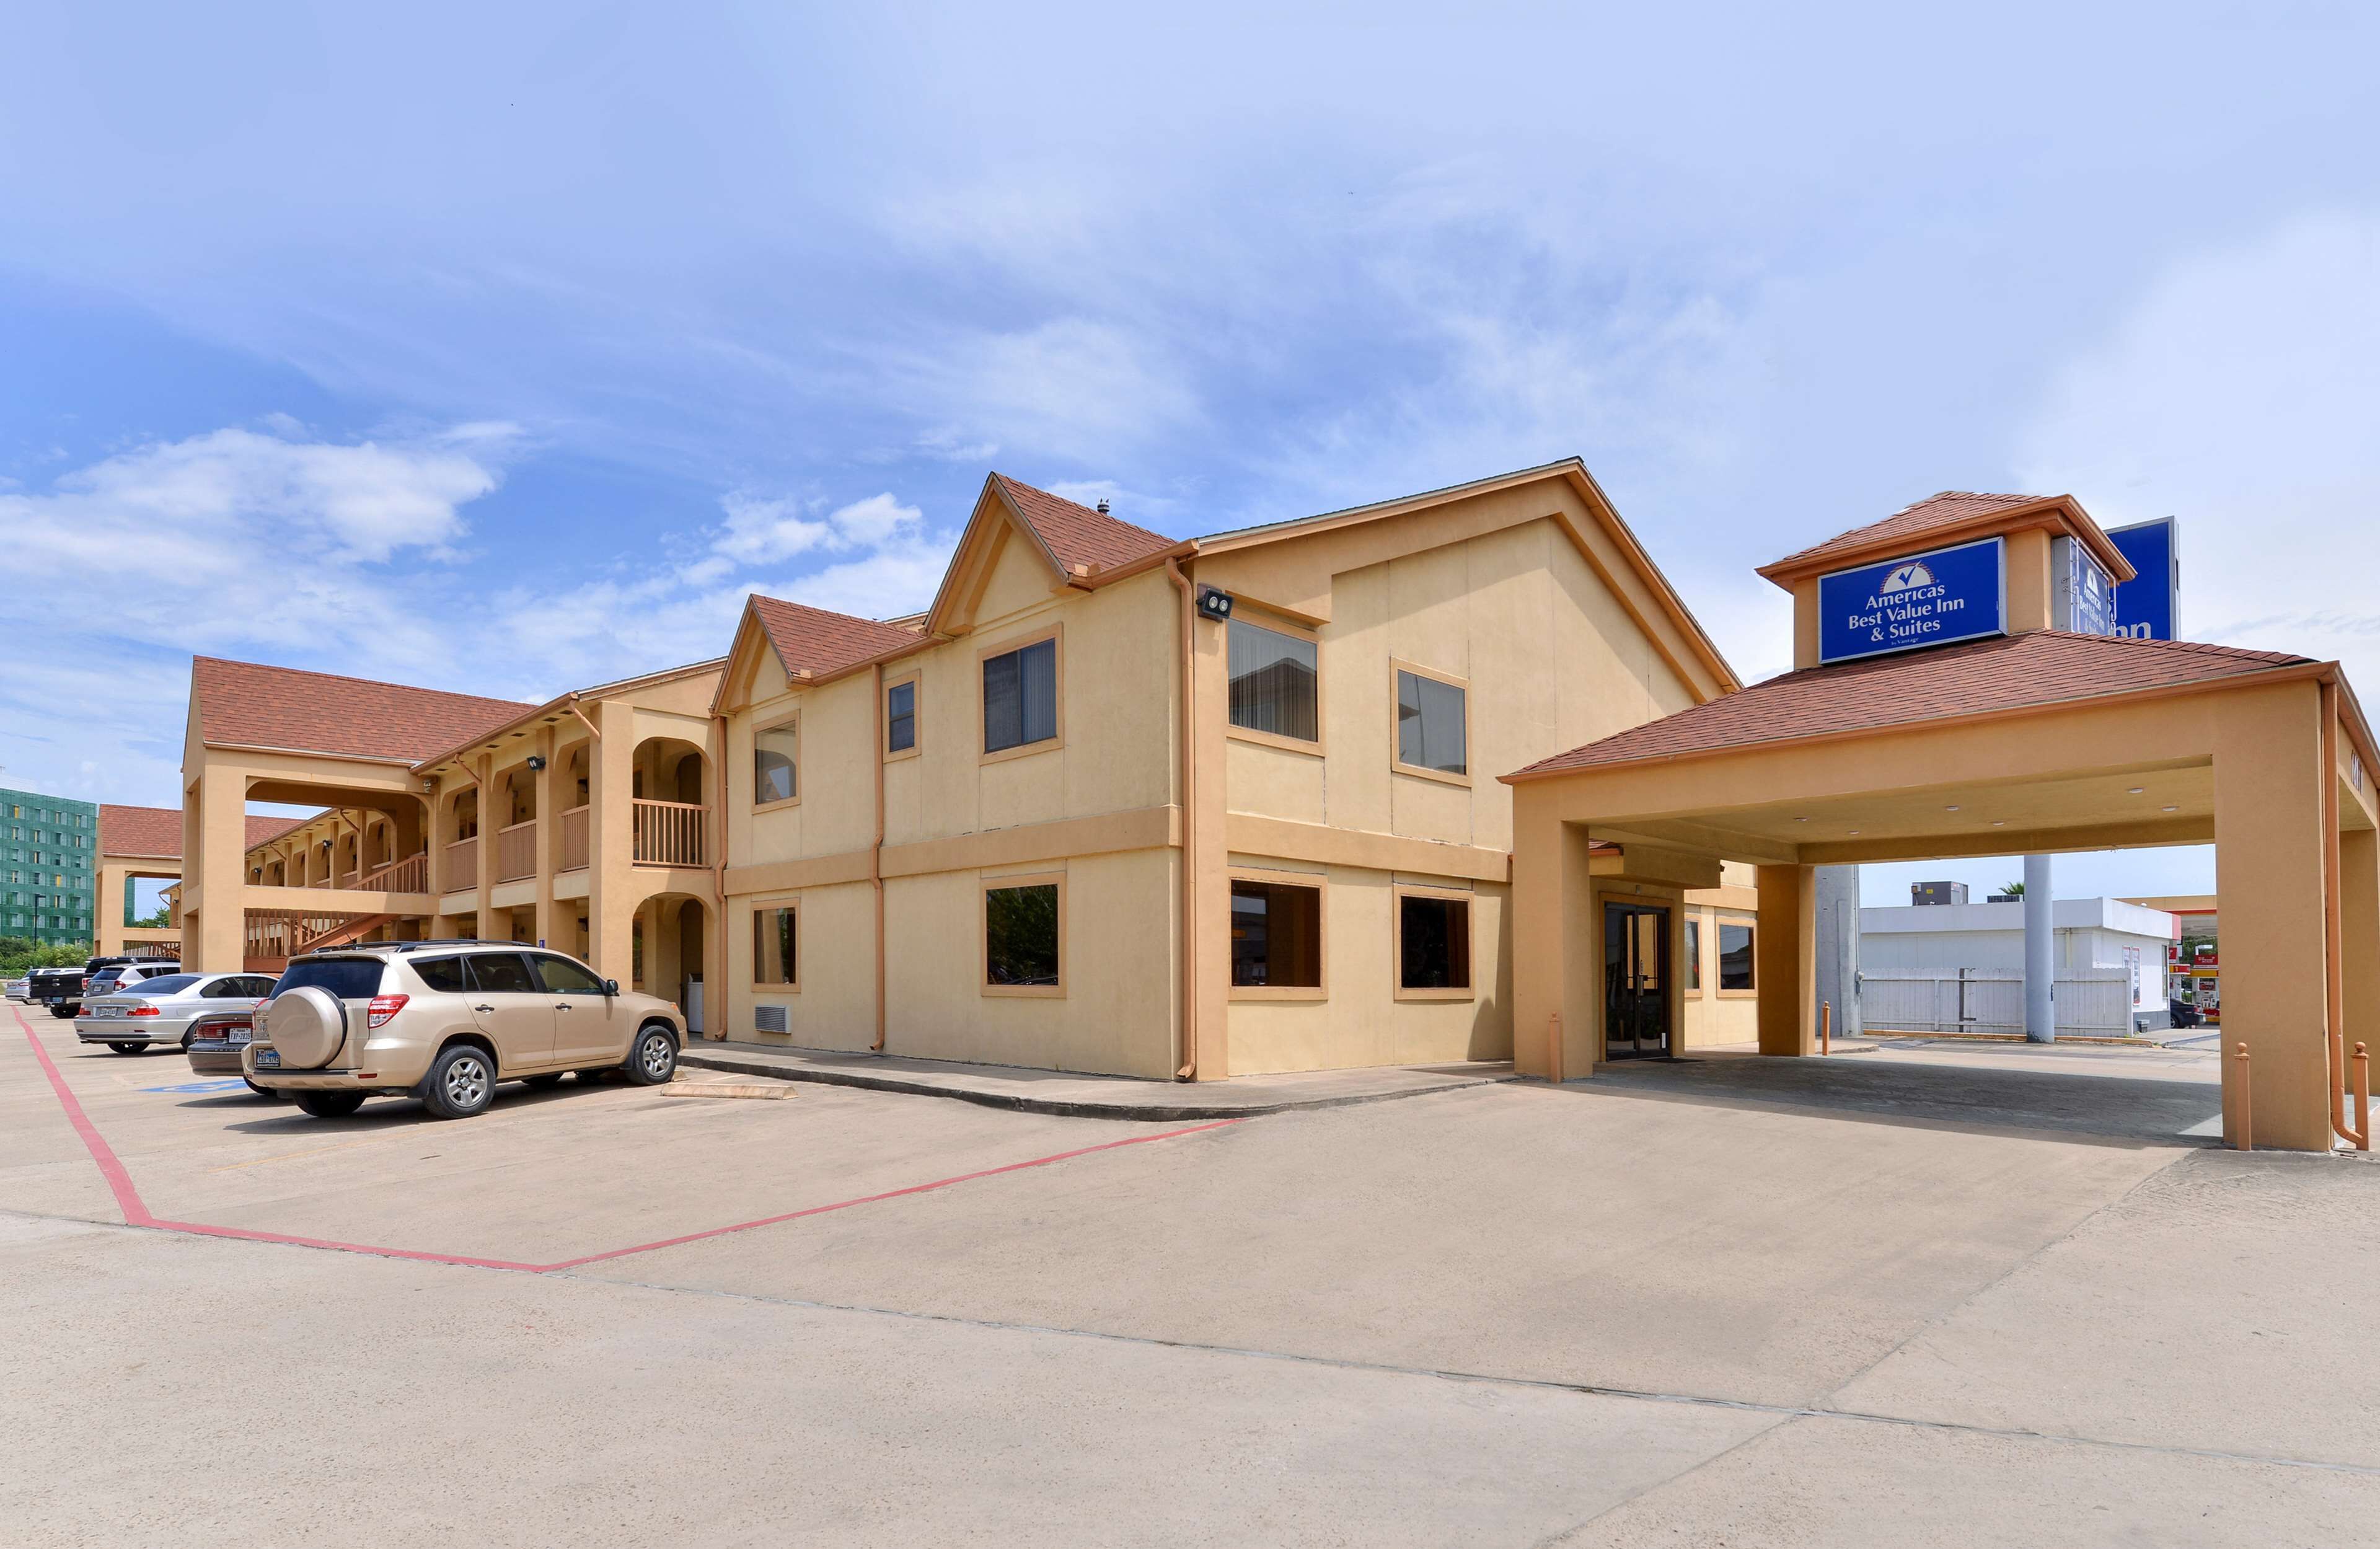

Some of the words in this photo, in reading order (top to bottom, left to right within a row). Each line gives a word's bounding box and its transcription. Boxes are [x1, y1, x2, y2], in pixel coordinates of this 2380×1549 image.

[1866, 585, 1945, 610] Americas
[1849, 611, 1882, 629] Best
[1887, 604, 1932, 621] Value
[1937, 598, 1964, 612] Inn
[1871, 627, 1885, 642] &
[1889, 620, 1941, 638] Suites
